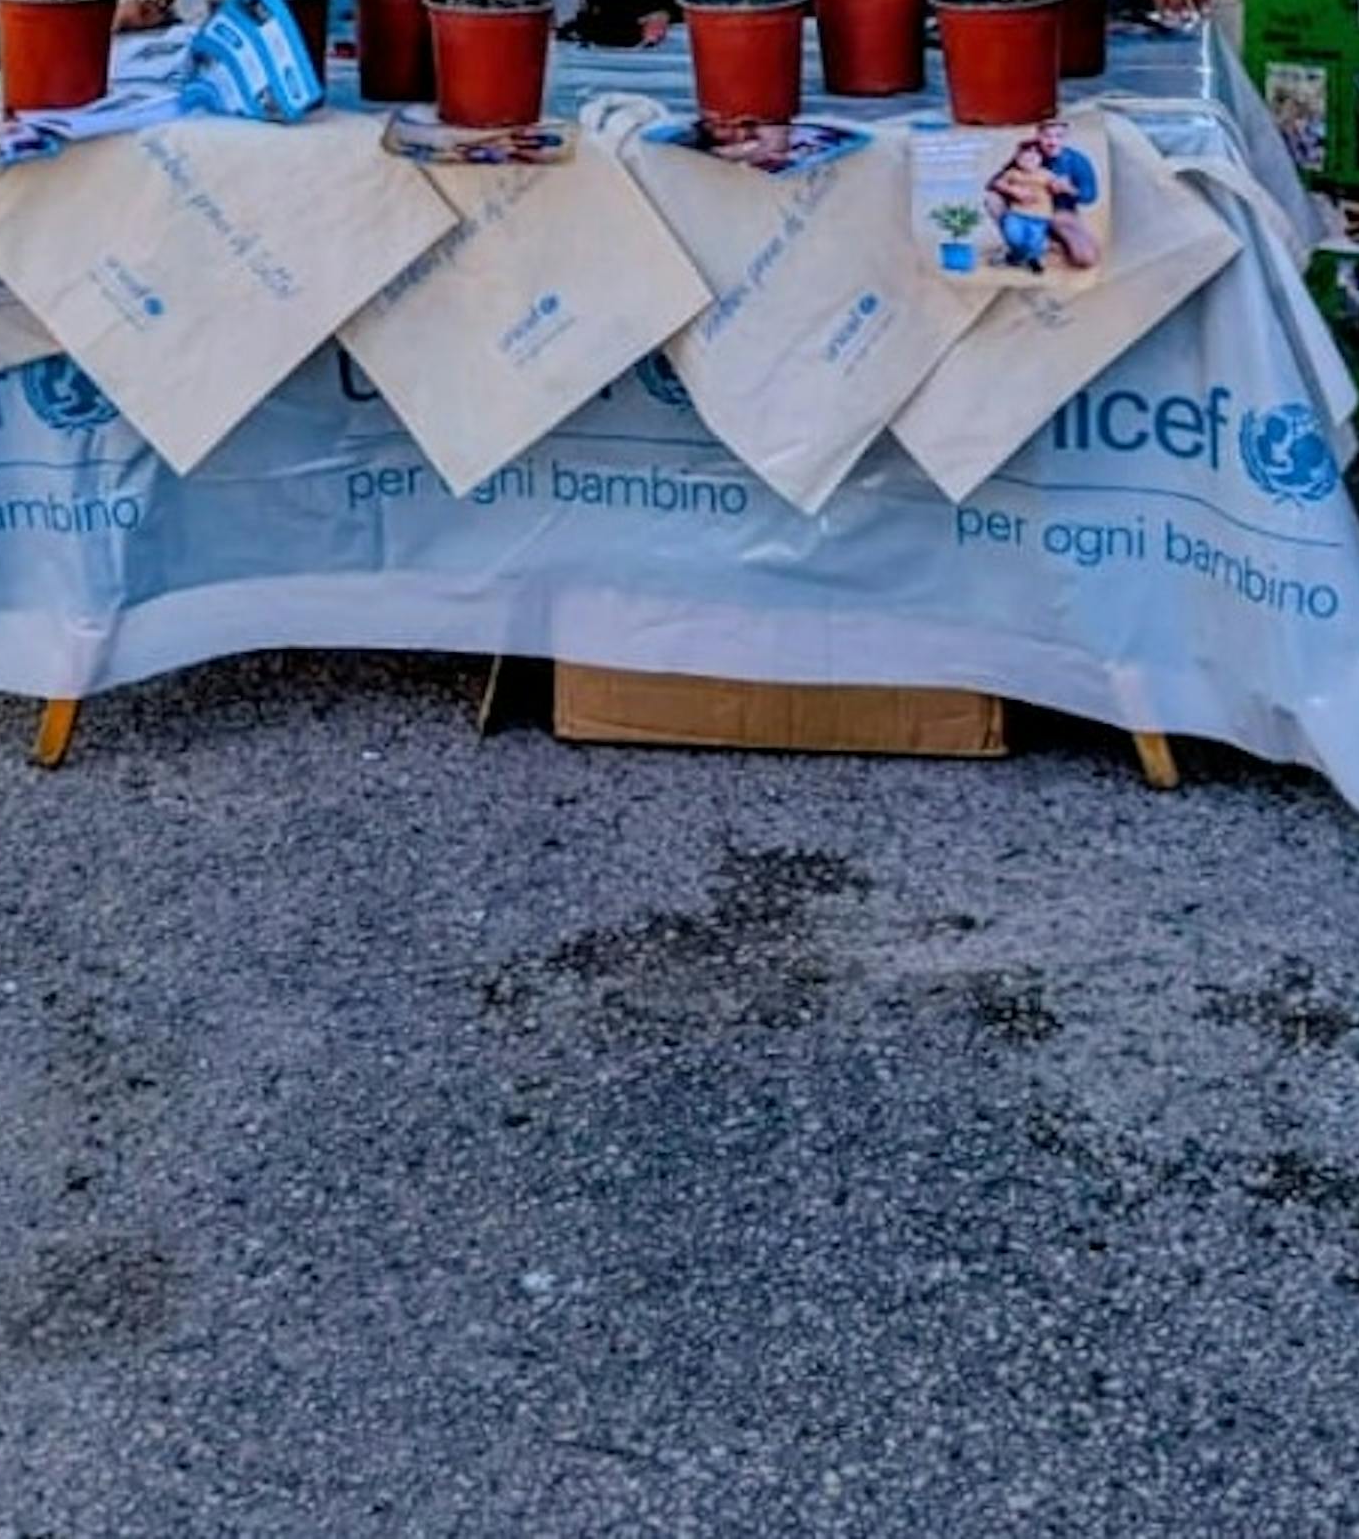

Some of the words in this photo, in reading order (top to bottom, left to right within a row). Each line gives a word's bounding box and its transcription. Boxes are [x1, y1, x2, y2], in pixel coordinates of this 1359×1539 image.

[1053, 386, 1231, 471] icef
[346, 463, 421, 510] per
[444, 459, 535, 505] gni
[551, 462, 748, 514] bambino
[956, 505, 1028, 548] per
[1043, 517, 1146, 567] ogni
[1166, 521, 1339, 620] bambino
